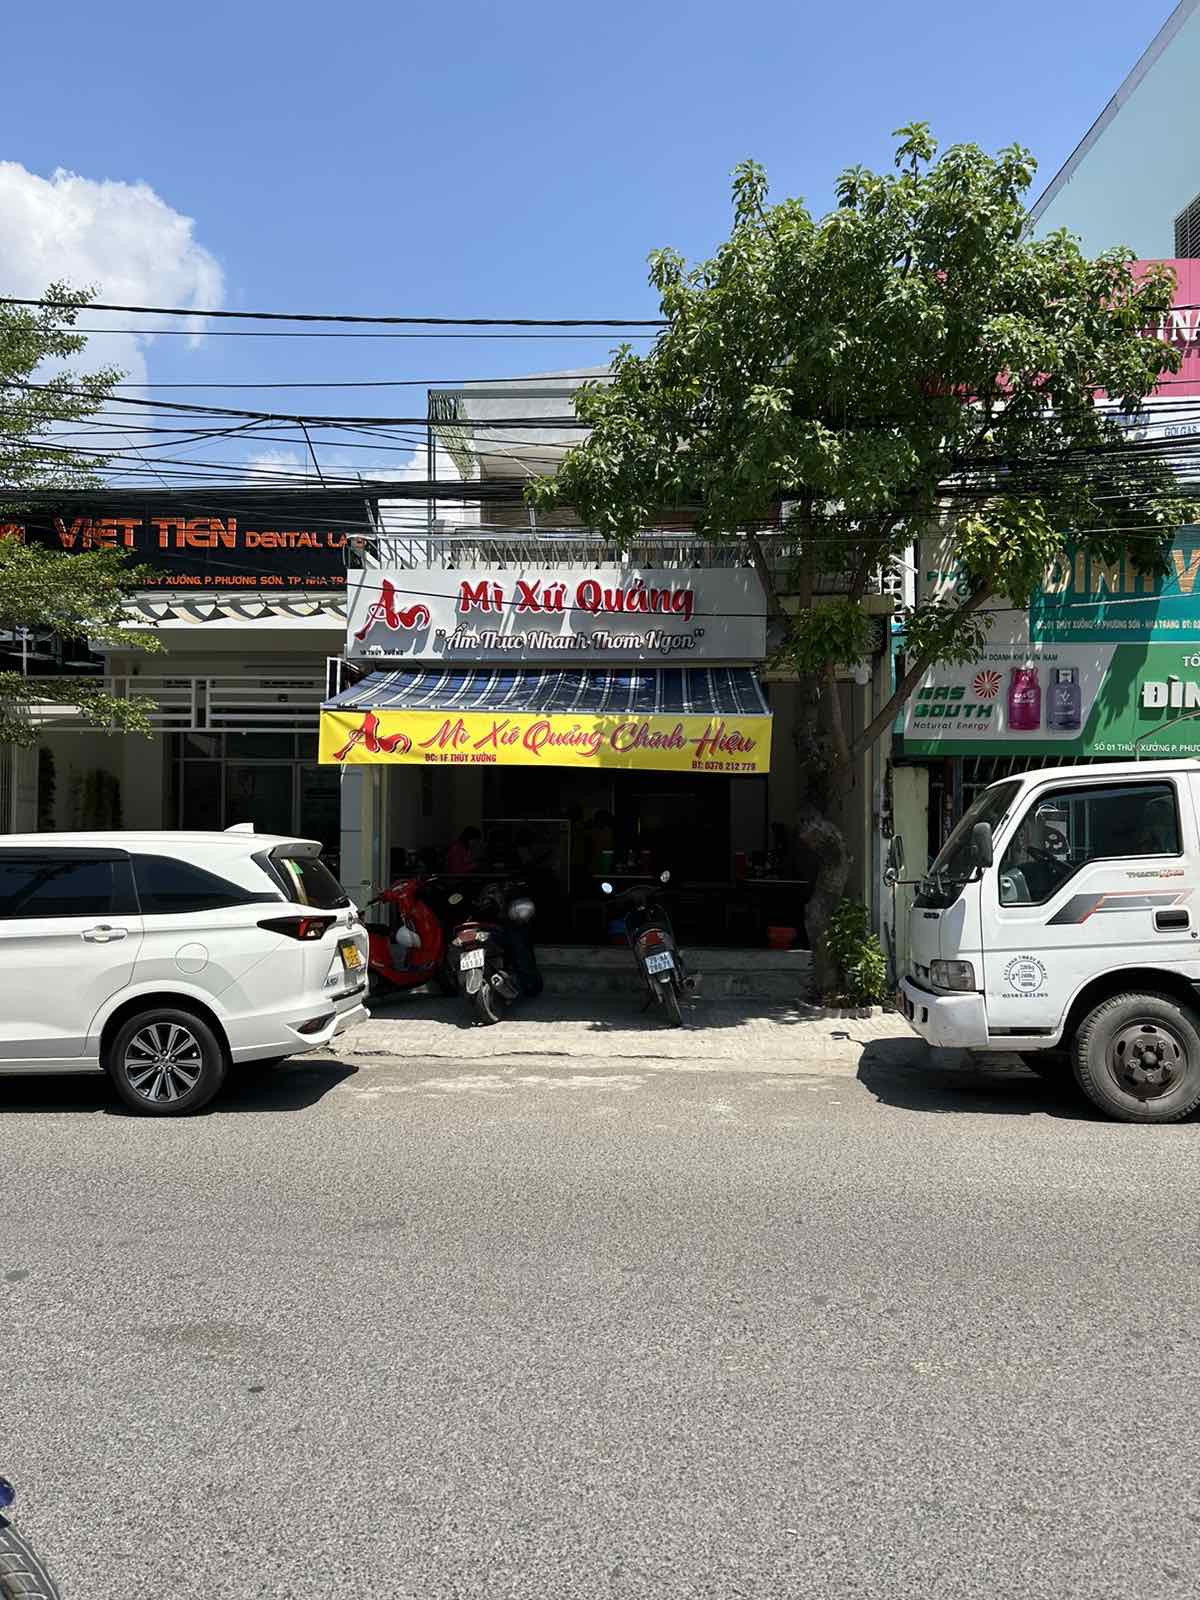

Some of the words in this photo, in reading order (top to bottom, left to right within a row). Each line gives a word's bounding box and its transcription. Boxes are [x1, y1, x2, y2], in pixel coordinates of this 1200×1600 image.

[245, 531, 323, 548] DENTAL
[459, 579, 503, 613] Mì
[516, 579, 567, 613] Xứ
[576, 577, 694, 623] Quảng
[480, 631, 525, 653] Thực
[527, 630, 590, 650] Nhanh
[591, 630, 643, 650] Thơm
[914, 703, 993, 718] SOUTH
[913, 722, 952, 730] Natural
[956, 722, 990, 733] Energy
[522, 719, 604, 758] Quảng
[1106, 743, 1116, 751] 01
